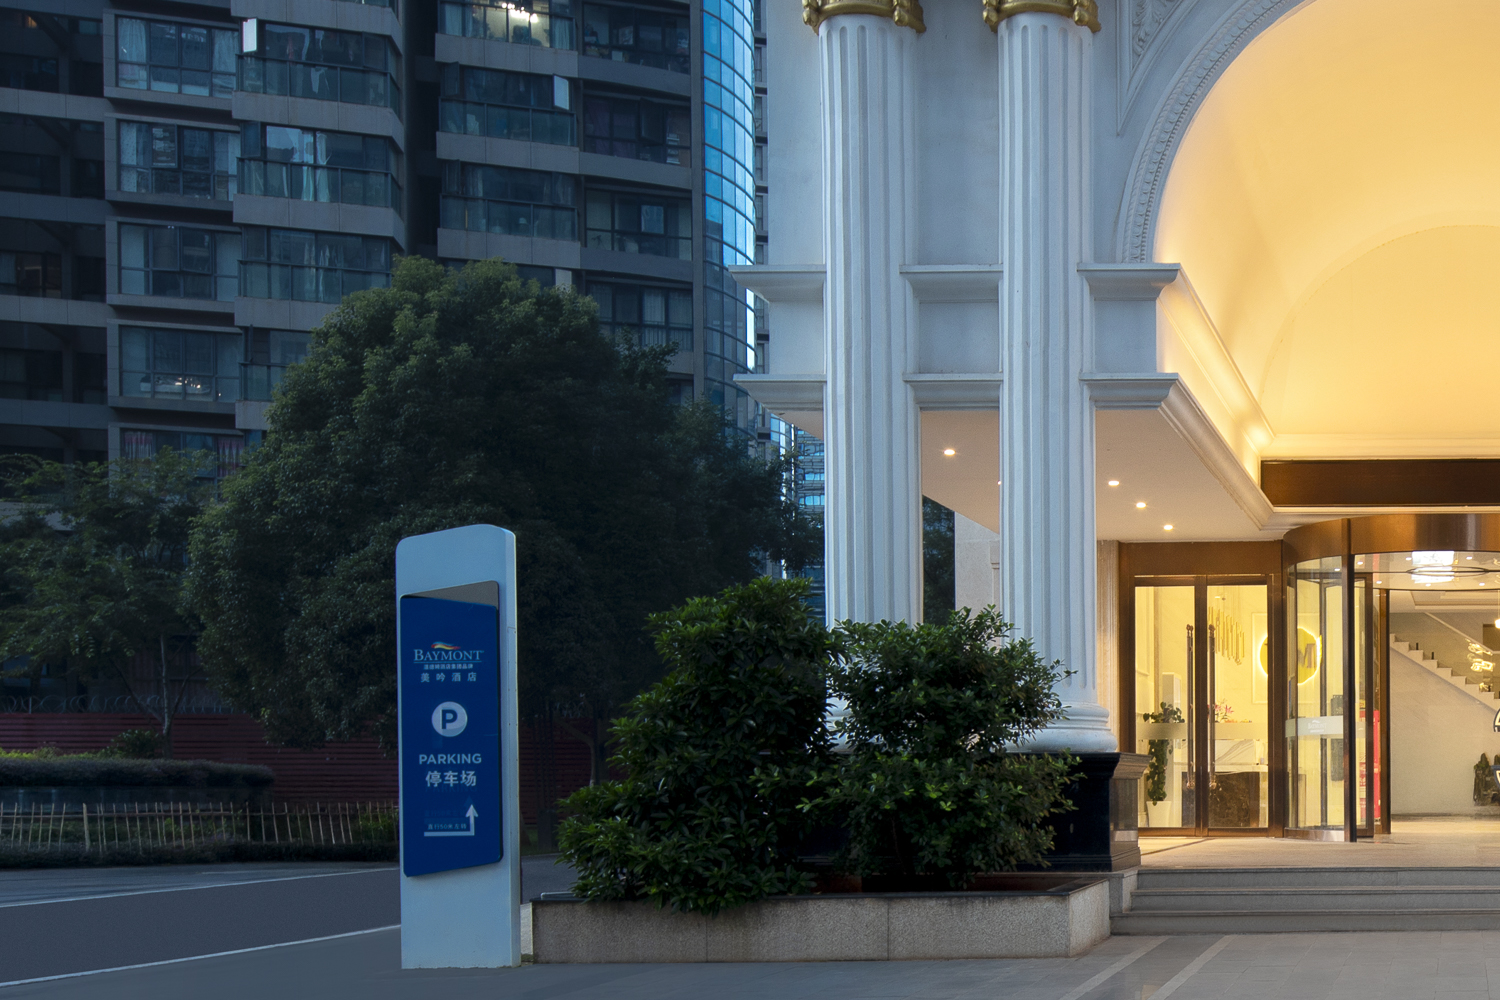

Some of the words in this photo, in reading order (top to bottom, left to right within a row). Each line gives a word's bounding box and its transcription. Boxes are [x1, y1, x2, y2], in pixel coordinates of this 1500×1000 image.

[413, 649, 481, 661] BAYMONT
[420, 672, 477, 683] 美吟酒店
[441, 709, 458, 730] P
[419, 753, 482, 765] PARKING
[426, 770, 477, 787] 停车场
